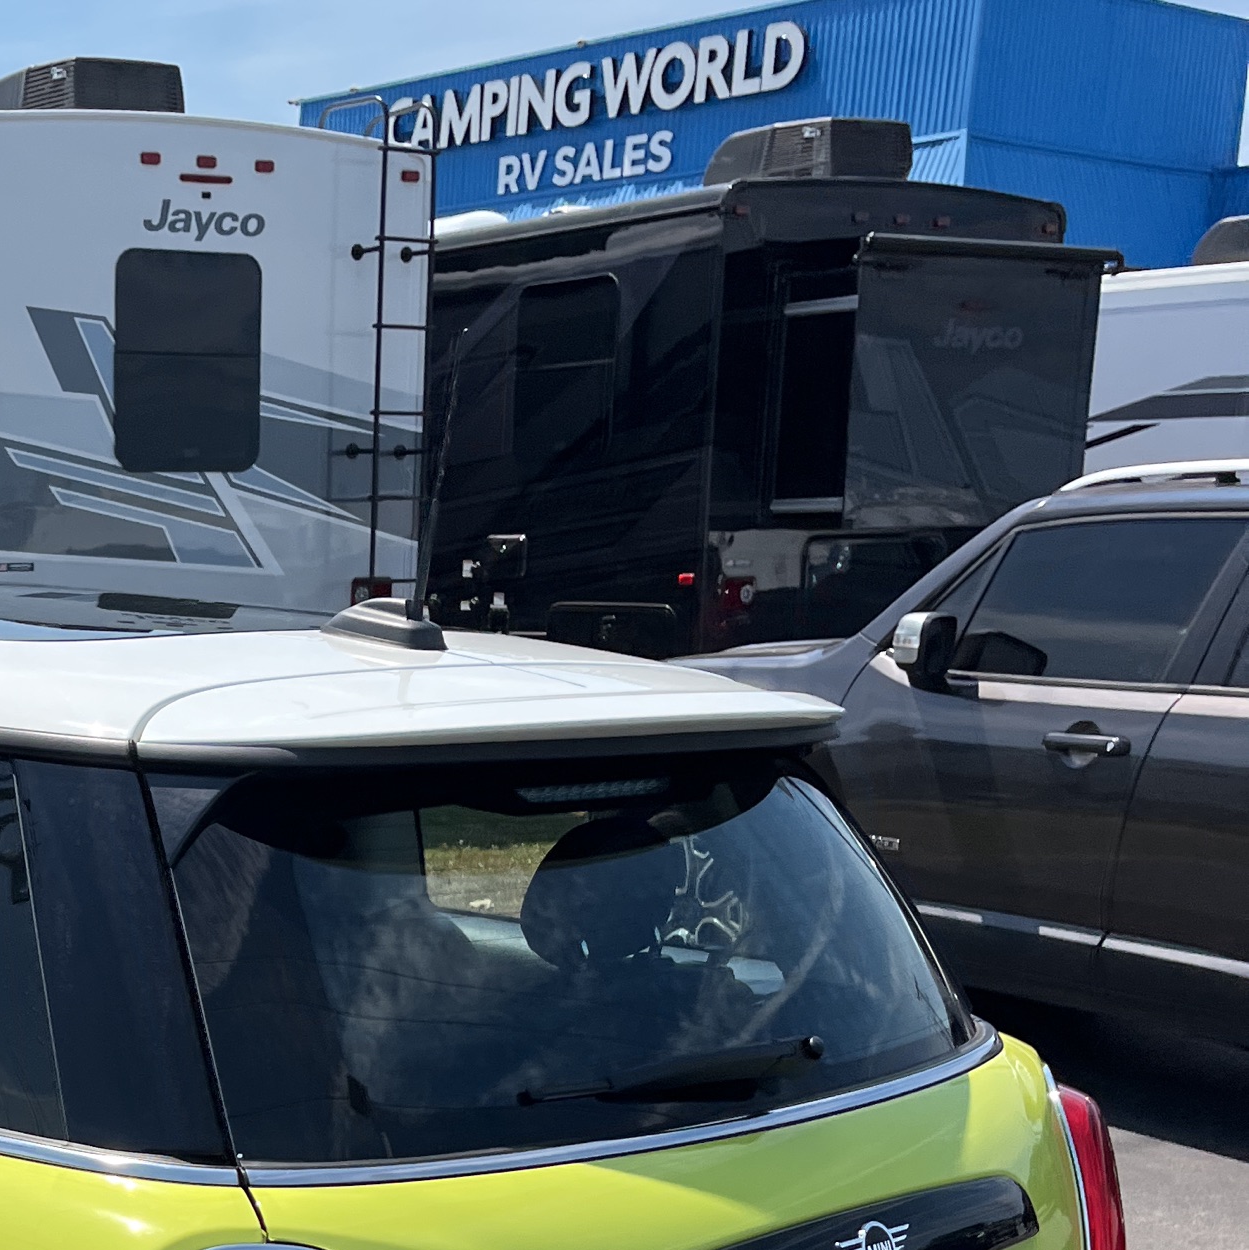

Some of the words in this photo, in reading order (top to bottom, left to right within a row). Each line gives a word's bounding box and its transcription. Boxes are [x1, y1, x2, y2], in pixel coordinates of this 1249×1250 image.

[388, 61, 592, 149] CAMPING
[601, 20, 806, 118] WORLD
[496, 149, 548, 195] RV
[552, 130, 674, 187] SALES
[143, 199, 266, 241] Jayco
